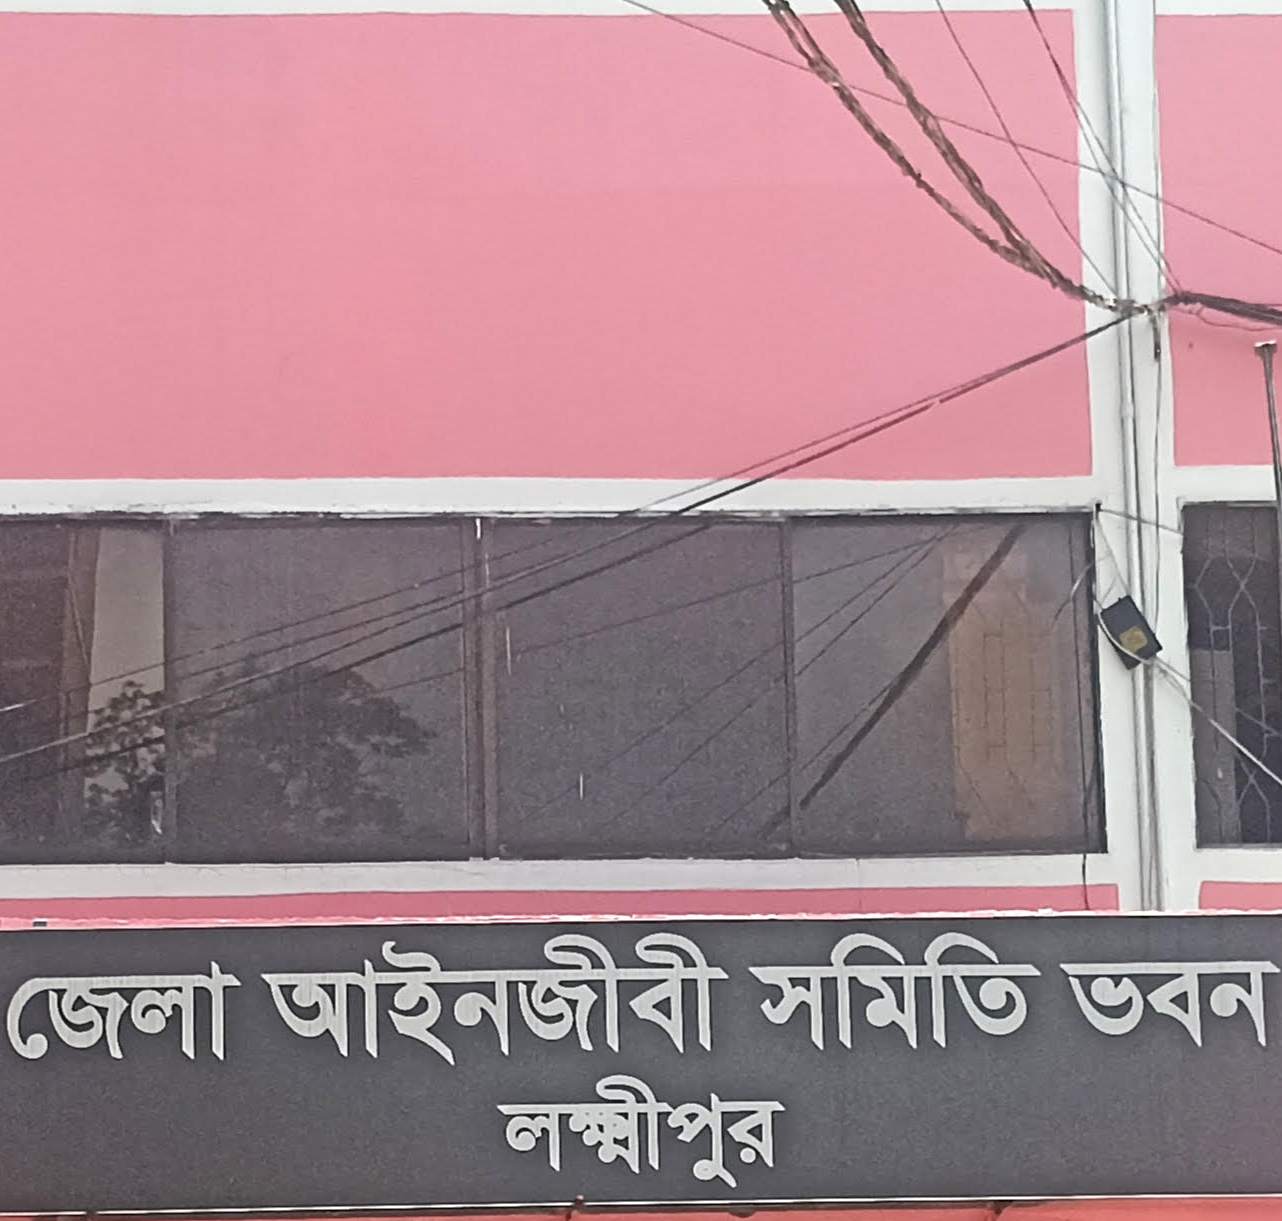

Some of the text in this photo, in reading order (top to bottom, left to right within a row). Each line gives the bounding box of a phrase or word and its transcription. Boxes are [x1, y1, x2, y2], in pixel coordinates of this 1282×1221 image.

[7, 932, 1281, 1065] জেলা আইনজীবী সমিতি ভবন
[497, 1074, 784, 1188] লক্ষ্মীপুর
